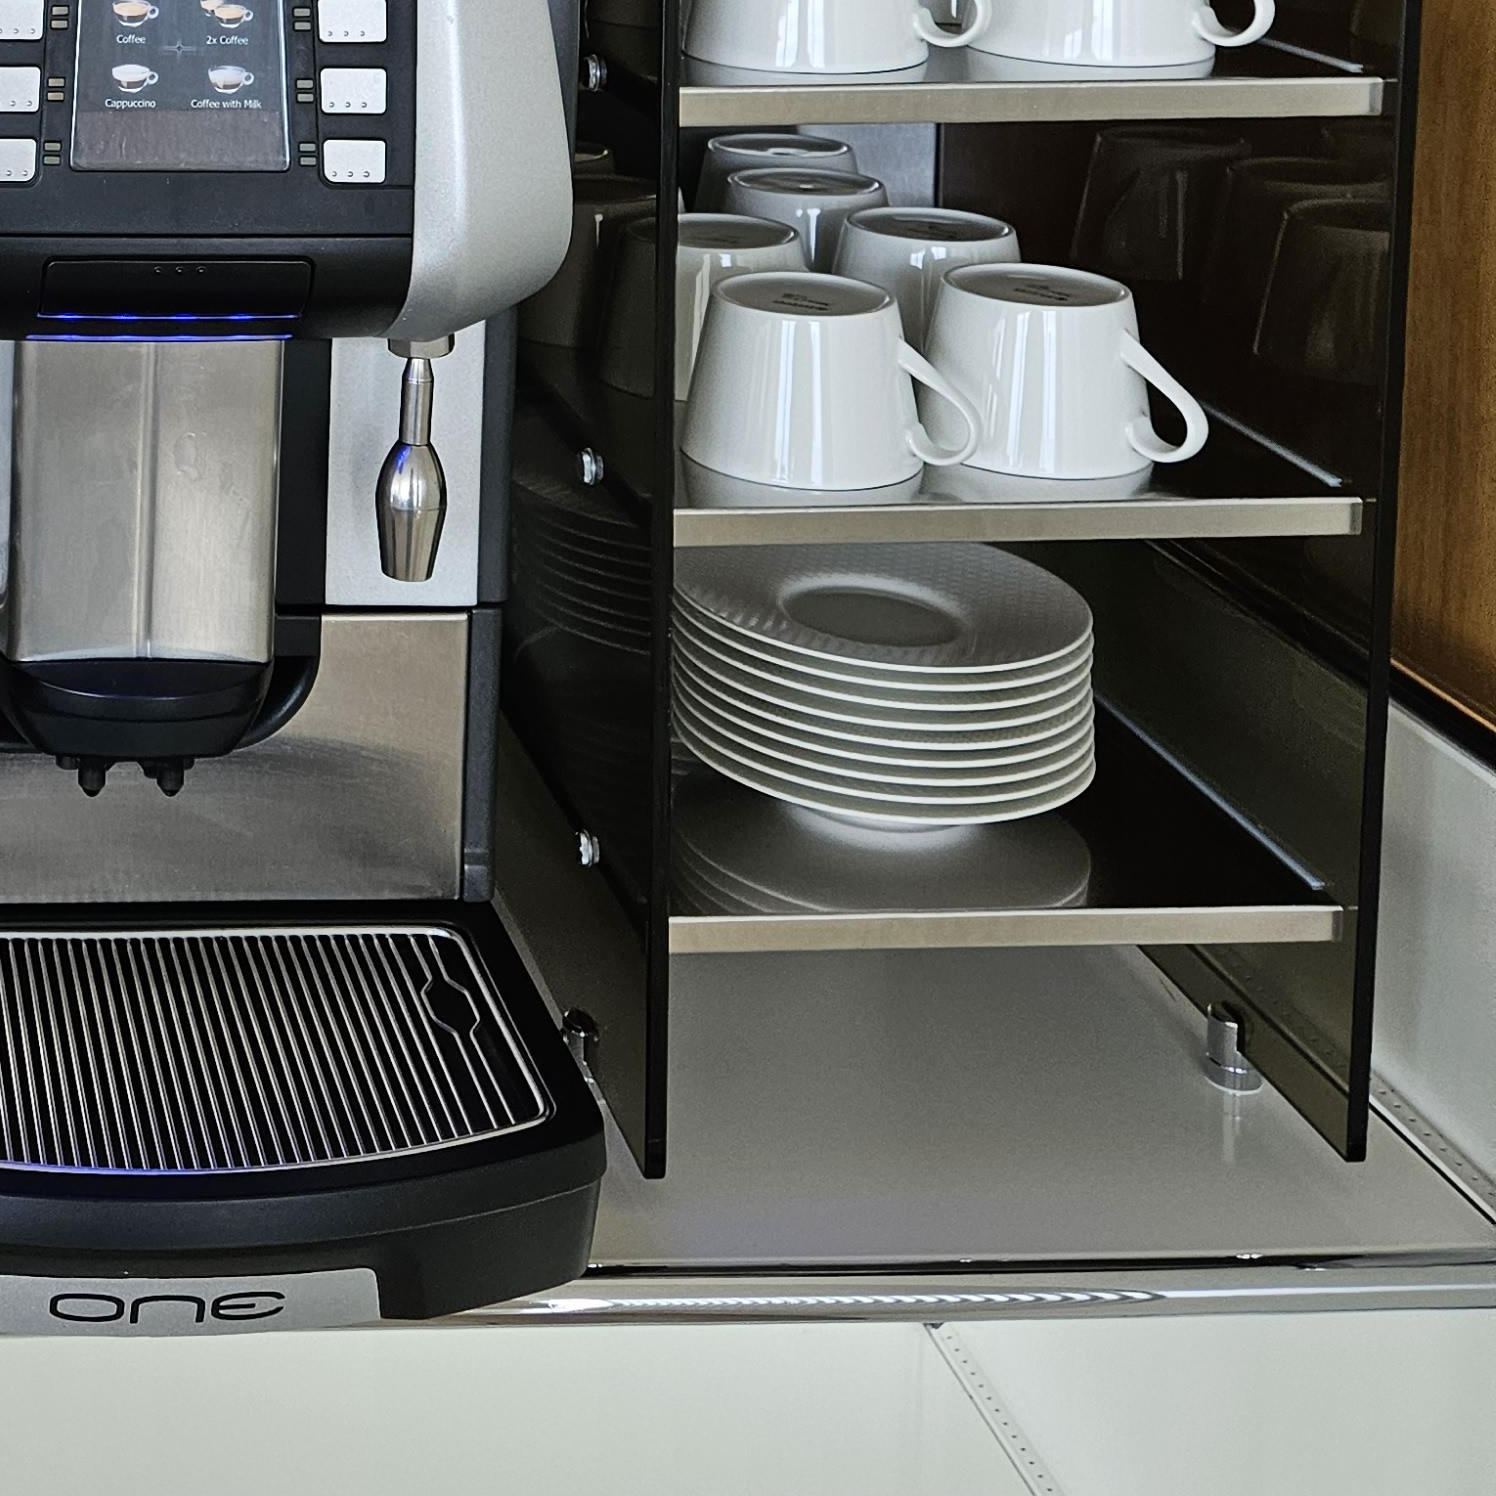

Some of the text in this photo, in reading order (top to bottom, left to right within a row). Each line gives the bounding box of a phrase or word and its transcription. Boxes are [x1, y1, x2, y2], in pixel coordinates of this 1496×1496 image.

[115, 33, 147, 45] Coffee
[205, 34, 249, 46] 2x Coffee
[104, 98, 157, 110] Cappuccino
[190, 98, 263, 109] Coffee with Milk
